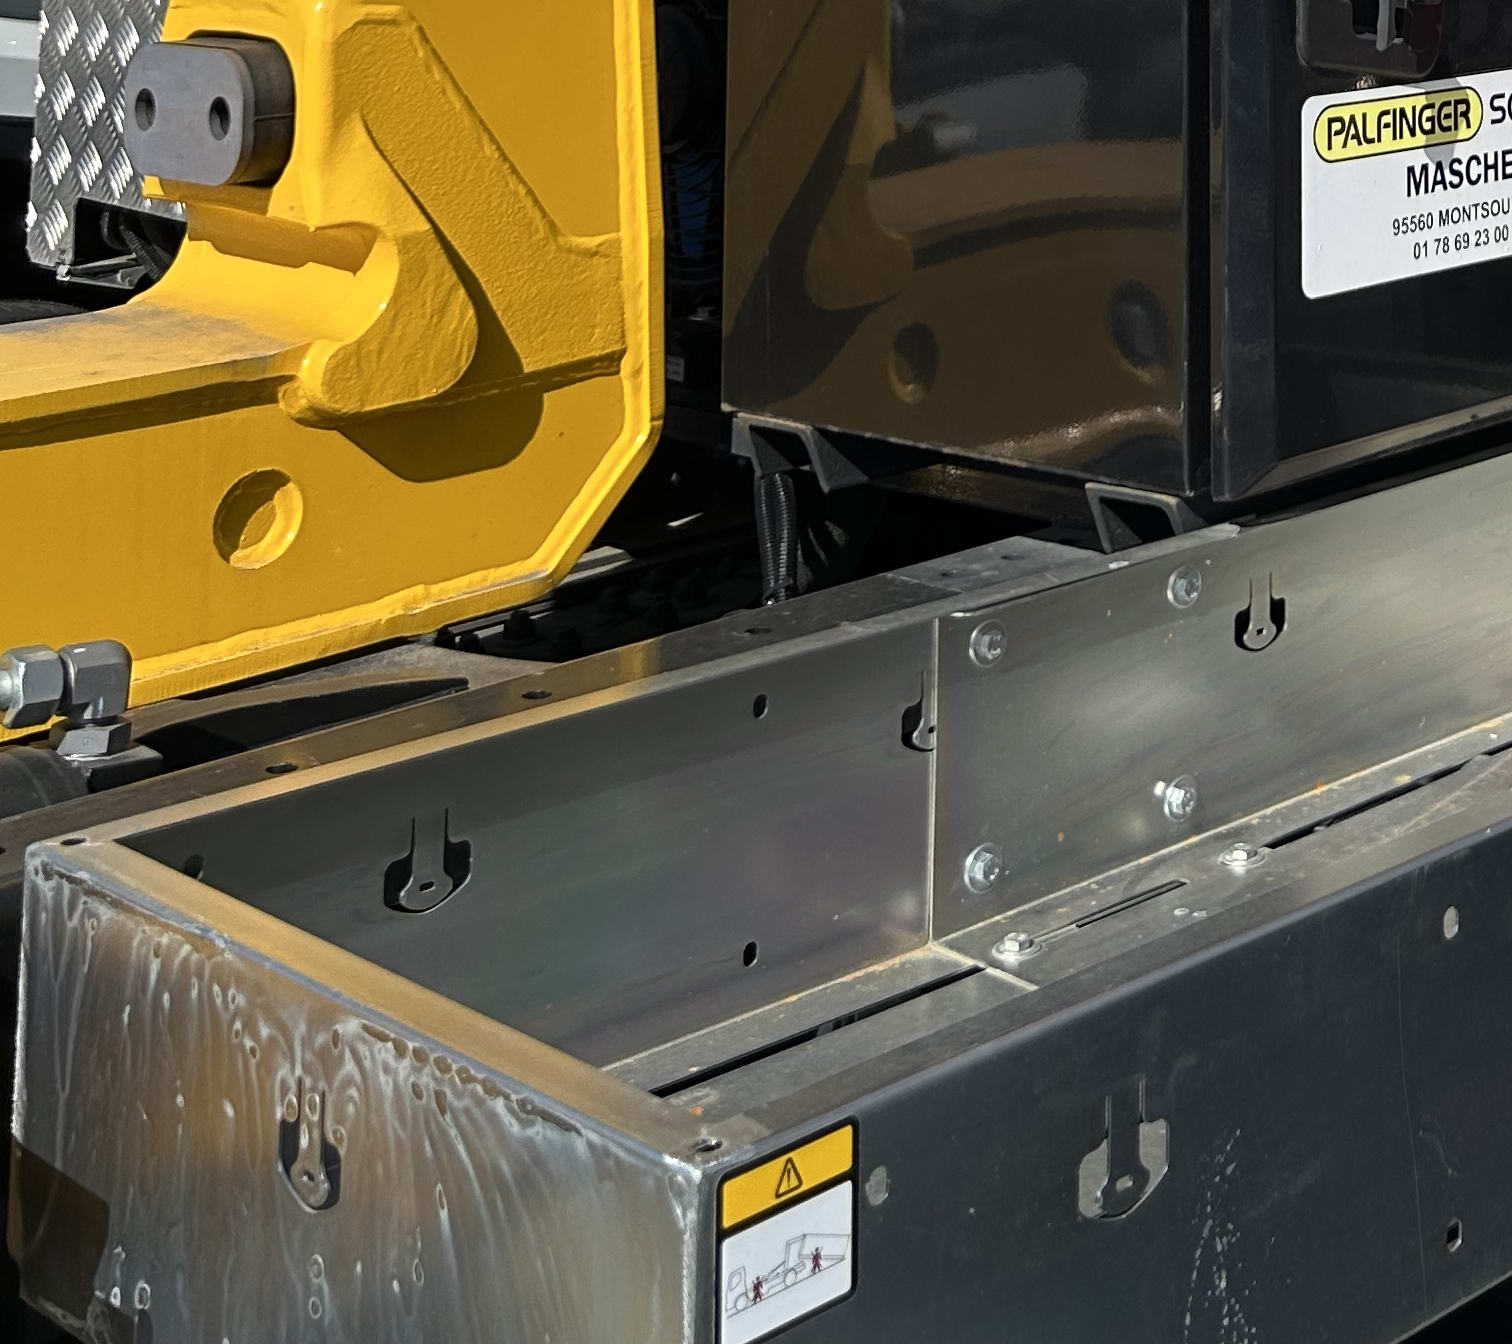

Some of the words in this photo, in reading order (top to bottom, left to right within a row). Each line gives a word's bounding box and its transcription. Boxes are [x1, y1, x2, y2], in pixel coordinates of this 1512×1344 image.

[1326, 97, 1472, 151] PALFINGER
[1392, 215, 1434, 237] 95560
[1413, 241, 1429, 260] 01
[1433, 236, 1450, 256] 78
[1454, 231, 1471, 251] 69
[1474, 228, 1490, 247] 23
[1494, 223, 1510, 243] 00
